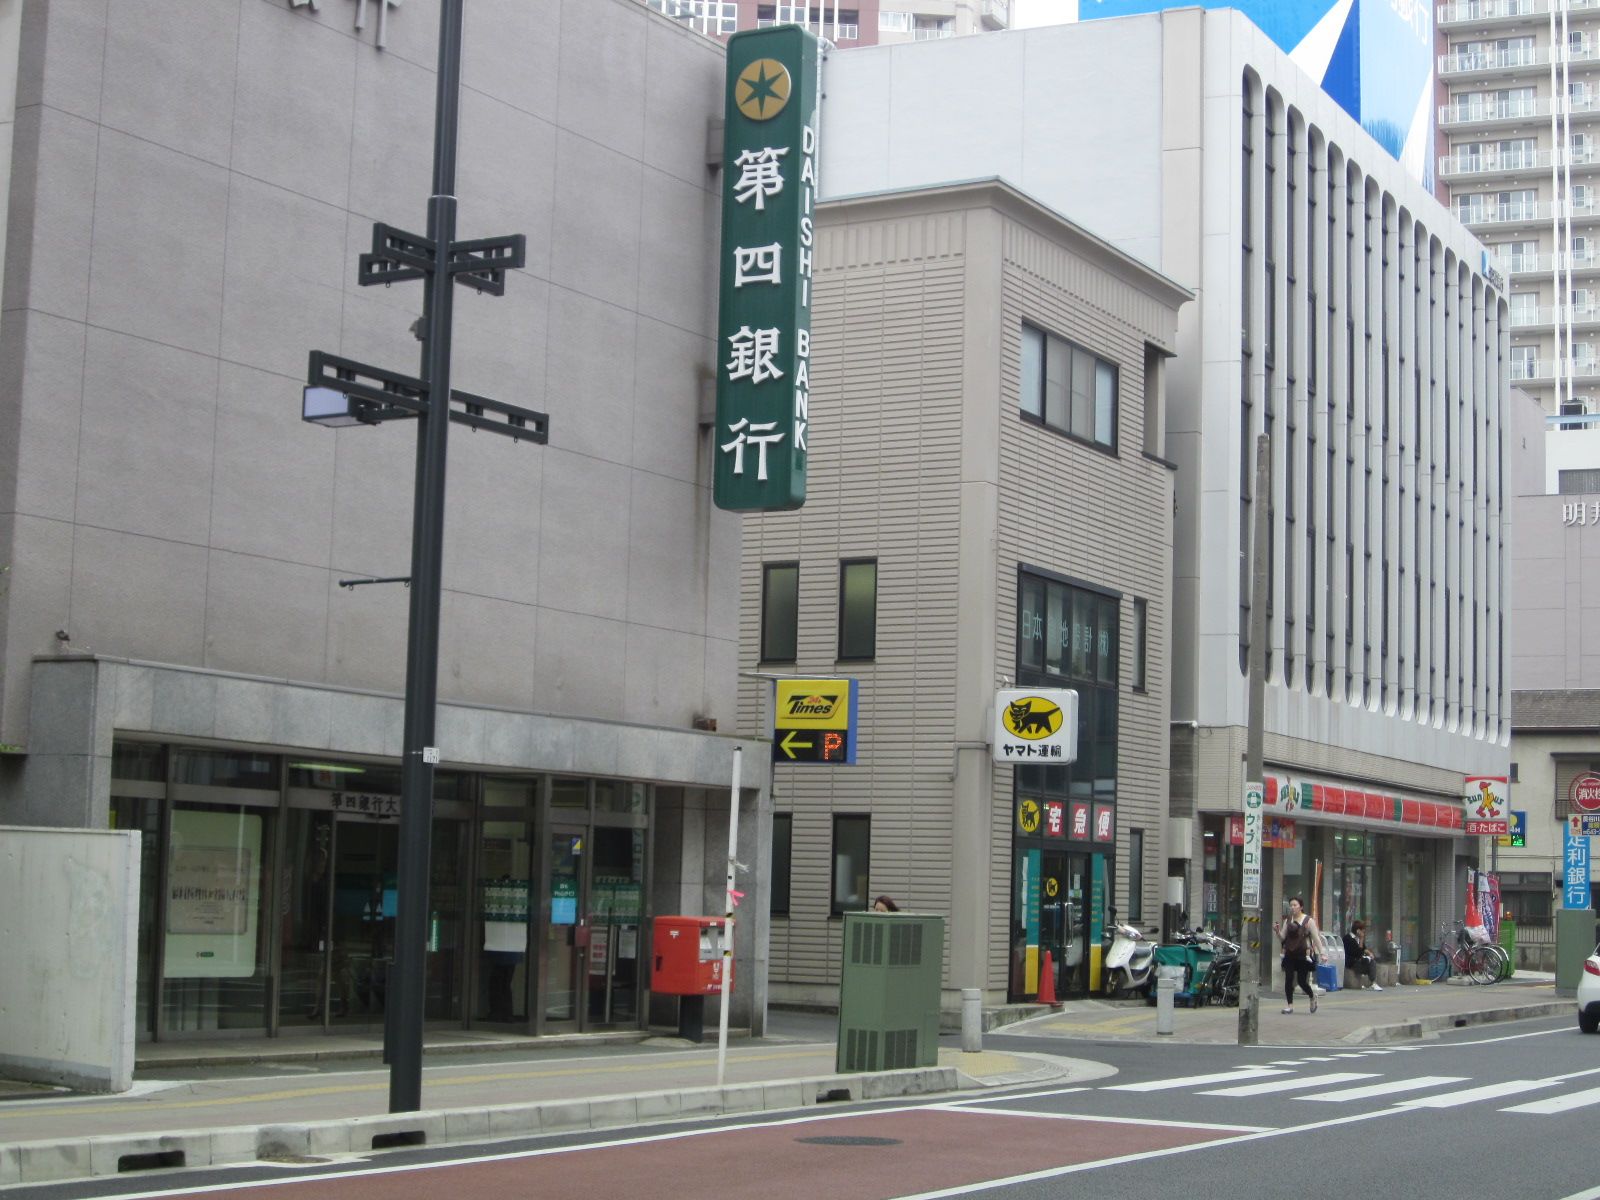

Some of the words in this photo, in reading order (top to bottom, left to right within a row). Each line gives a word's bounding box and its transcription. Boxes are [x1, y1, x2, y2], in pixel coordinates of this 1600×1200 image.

[799, 124, 815, 309] DAISHI
[720, 145, 790, 482] 第四銀行
[795, 328, 811, 452] BANK
[788, 695, 833, 715] Times
[824, 733, 842, 760] P
[1003, 744, 1062, 758] ヤマト運輸
[1048, 805, 1111, 837] 宅急便
[1567, 836, 1586, 905] 足利銀行
